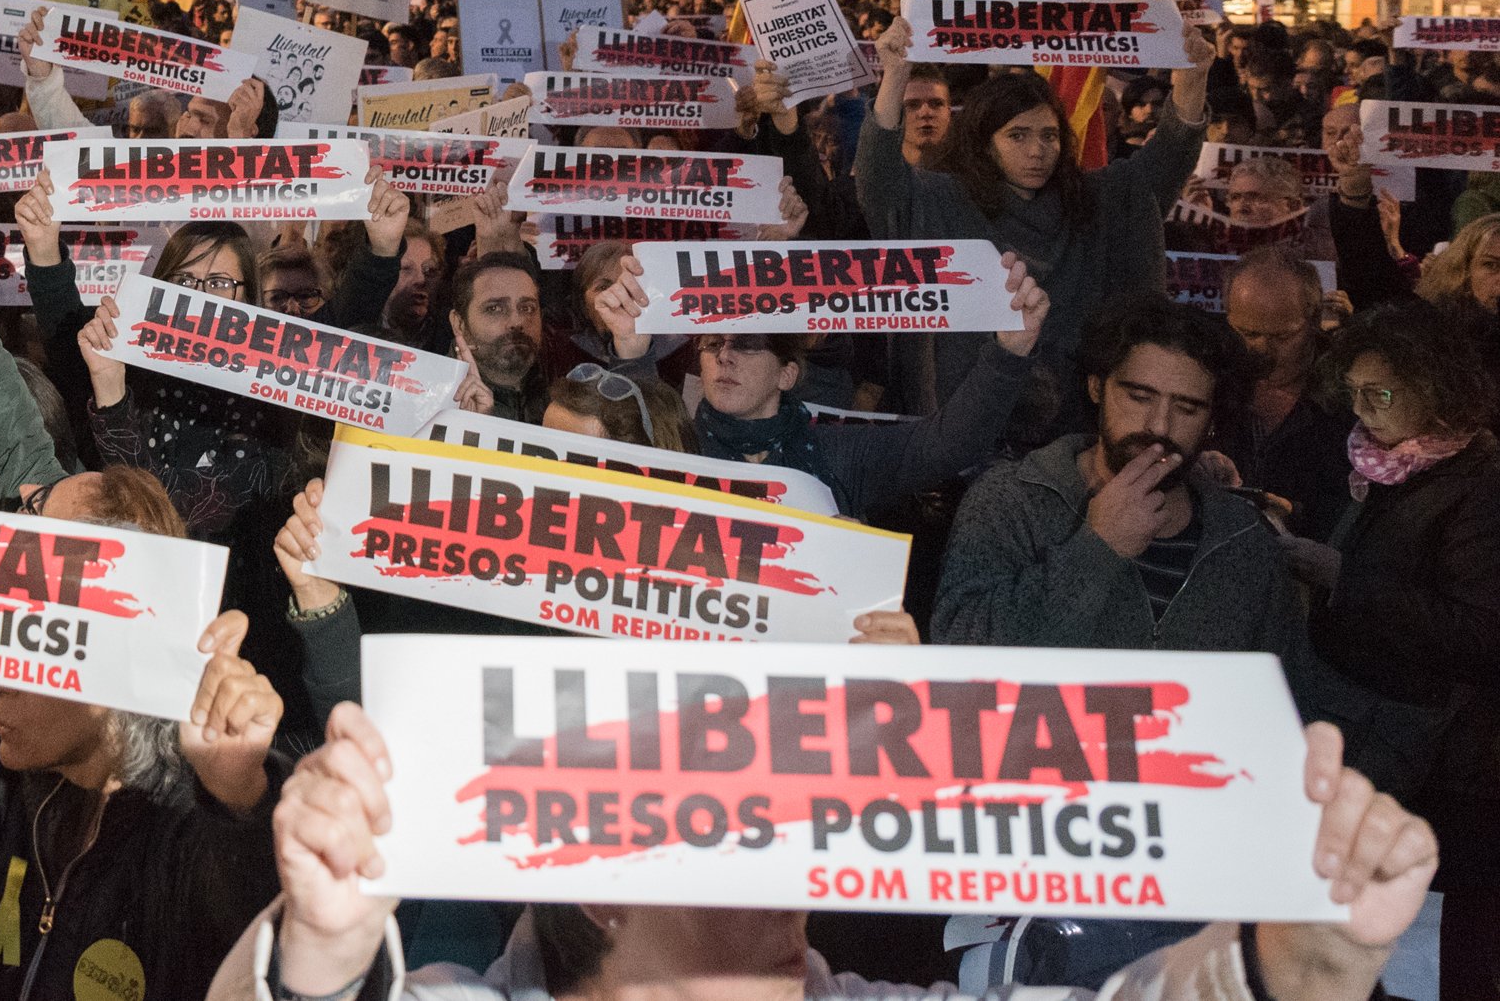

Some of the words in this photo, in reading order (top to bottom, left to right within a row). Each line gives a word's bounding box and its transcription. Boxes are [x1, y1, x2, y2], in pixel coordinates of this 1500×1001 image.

[757, 3, 828, 35] LLIBERTAT
[932, 0, 1140, 33] LLIBERTAT
[60, 15, 214, 67] LLIBERTAT
[266, 33, 332, 61] Llibertat!
[599, 31, 735, 64] LLIBERTAT
[768, 20, 828, 47] PRESOS
[769, 31, 838, 62] POLÍTICS
[936, 32, 1023, 49] PRESOS
[1032, 29, 1139, 53] POLÍTICS!
[59, 41, 121, 65] PRESOS
[126, 58, 206, 85] POLÍTICS!
[481, 48, 532, 57] LLIBERTAT
[1032, 53, 1064, 63] SOM
[1068, 52, 1140, 65] REPÚBLICA
[123, 70, 146, 82] SOM
[149, 78, 203, 95] REPÚBLICA
[660, 59, 733, 78] POLÍTICS!
[546, 76, 704, 102] LLIBERTAT
[370, 103, 434, 128] Llibertat!
[488, 105, 530, 132] Llibertat!
[618, 117, 642, 125] SOM
[645, 117, 700, 127] REPÚBLICA
[619, 100, 702, 117] POLÍTICS!
[77, 146, 320, 179] LLIBERTAT
[392, 163, 487, 184] POLÍTICS!
[533, 151, 734, 188] LLIBERTAT
[77, 183, 181, 205] PRESOS
[191, 179, 318, 203] POLÍTICS!
[389, 181, 417, 191] SOM
[422, 180, 486, 196] REPÚBLICA
[532, 182, 618, 202] PRESOS
[626, 185, 733, 208] POLÍTICS!
[189, 207, 228, 219] SOM
[232, 204, 318, 219] REPÚBLICA
[624, 205, 656, 216] SOM
[660, 204, 732, 220] REPÚBLICA
[675, 246, 944, 289] LLIBERTAT
[680, 291, 796, 315] PRESOS
[807, 284, 951, 313] POLÍTICS!
[143, 287, 407, 386] LLIBERTAT
[806, 317, 849, 331] SOM
[854, 313, 951, 330] REPÚBLICA
[137, 327, 246, 374] PRESOS
[256, 357, 392, 414] POLÍTICS!
[249, 381, 289, 404] SOM
[293, 390, 386, 430] REPÚBLICA
[369, 462, 779, 586] LLIBERTAT
[364, 527, 528, 587] PRESOS
[545, 566, 770, 634] POLÍTICS!
[539, 599, 601, 632] SOM
[481, 664, 1157, 790] LLIBERTAT
[483, 788, 775, 851] PRESOS
[810, 786, 1168, 861] POLÍTICS!
[806, 865, 910, 903] SOM
[929, 860, 1168, 909] REPÚBLICA
